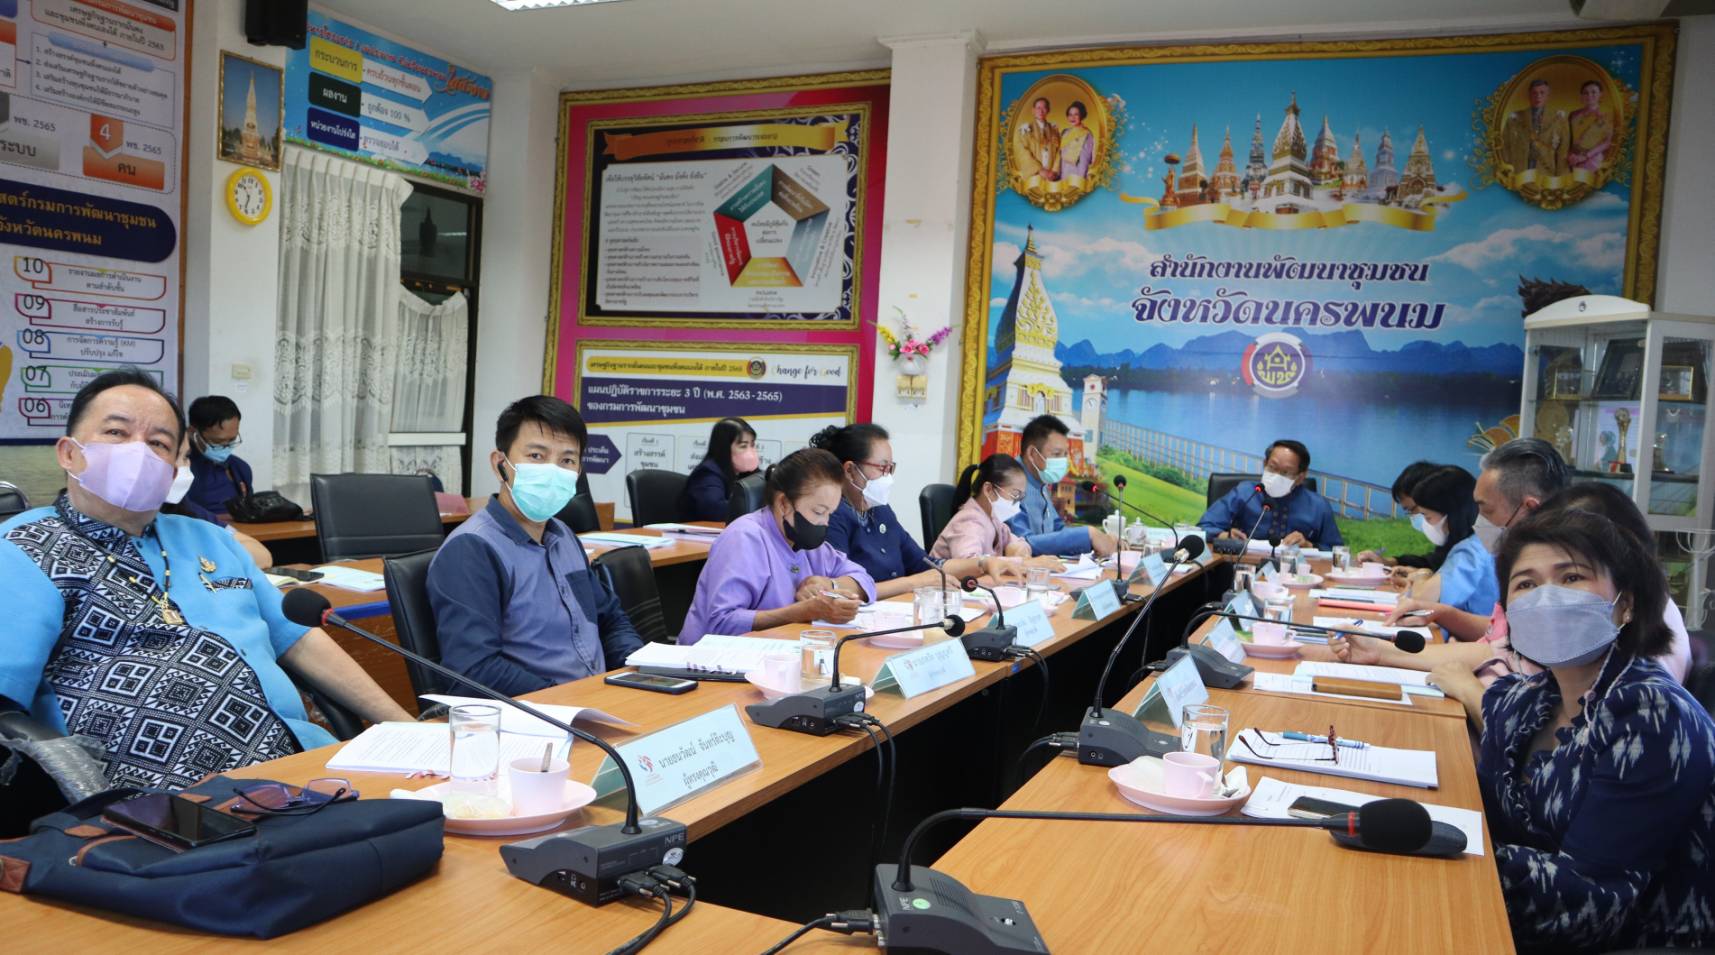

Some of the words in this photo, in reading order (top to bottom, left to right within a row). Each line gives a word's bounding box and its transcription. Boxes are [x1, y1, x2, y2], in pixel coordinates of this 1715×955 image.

[314, 49, 359, 72] กระบวนการ
[33, 119, 56, 132] 2565
[100, 123, 112, 141] 4
[117, 161, 136, 176] คน
[23, 256, 45, 274] 10
[1150, 254, 1430, 289] สำนักงานพัฒนาชุมชน
[23, 294, 46, 311] 09
[1132, 287, 1446, 329] จังหวัดนครพนม
[22, 328, 46, 346] 08
[25, 365, 47, 382] 07
[588, 384, 680, 398] แผนปฏิบัติราชการระยะ
[684, 388, 691, 398] 3
[694, 385, 701, 398] ปี
[24, 397, 47, 413] 06
[587, 401, 686, 417] ของกรมการพัฒนาชุมชน
